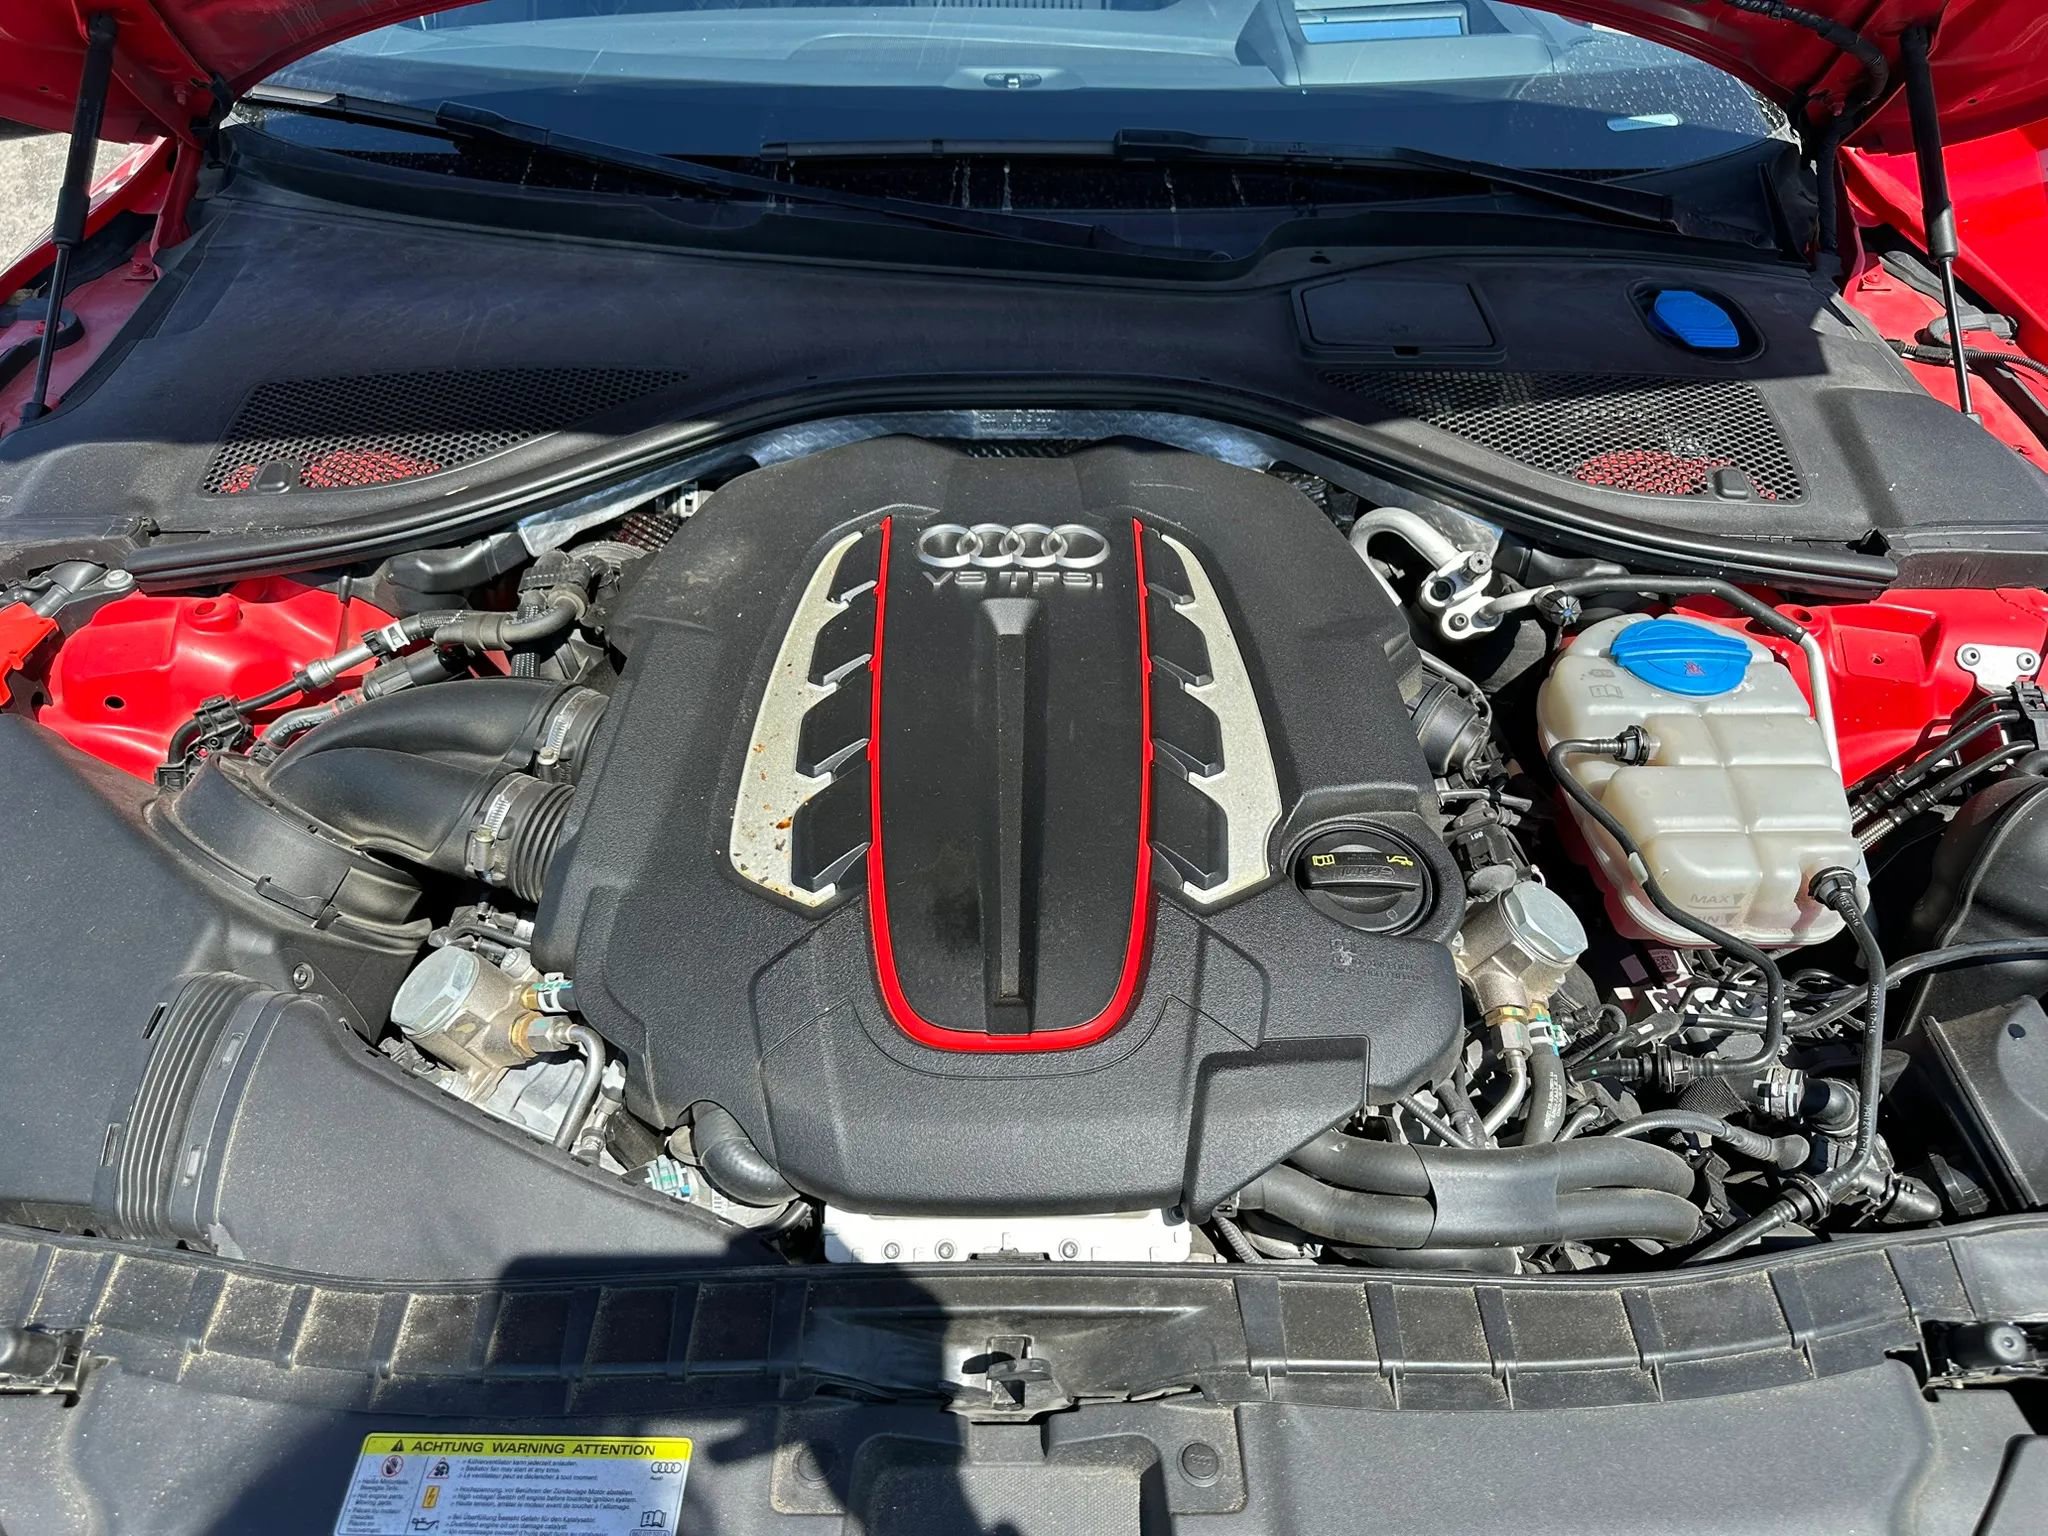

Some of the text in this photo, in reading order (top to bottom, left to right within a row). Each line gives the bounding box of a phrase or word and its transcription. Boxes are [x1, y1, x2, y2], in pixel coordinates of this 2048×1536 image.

[998, 570, 1104, 591] TFSI
[1690, 893, 1731, 905] MAX
[1868, 1012, 1878, 1034] 17-16
[411, 1440, 657, 1456] ACHTUNG WARNING ATTENTION
